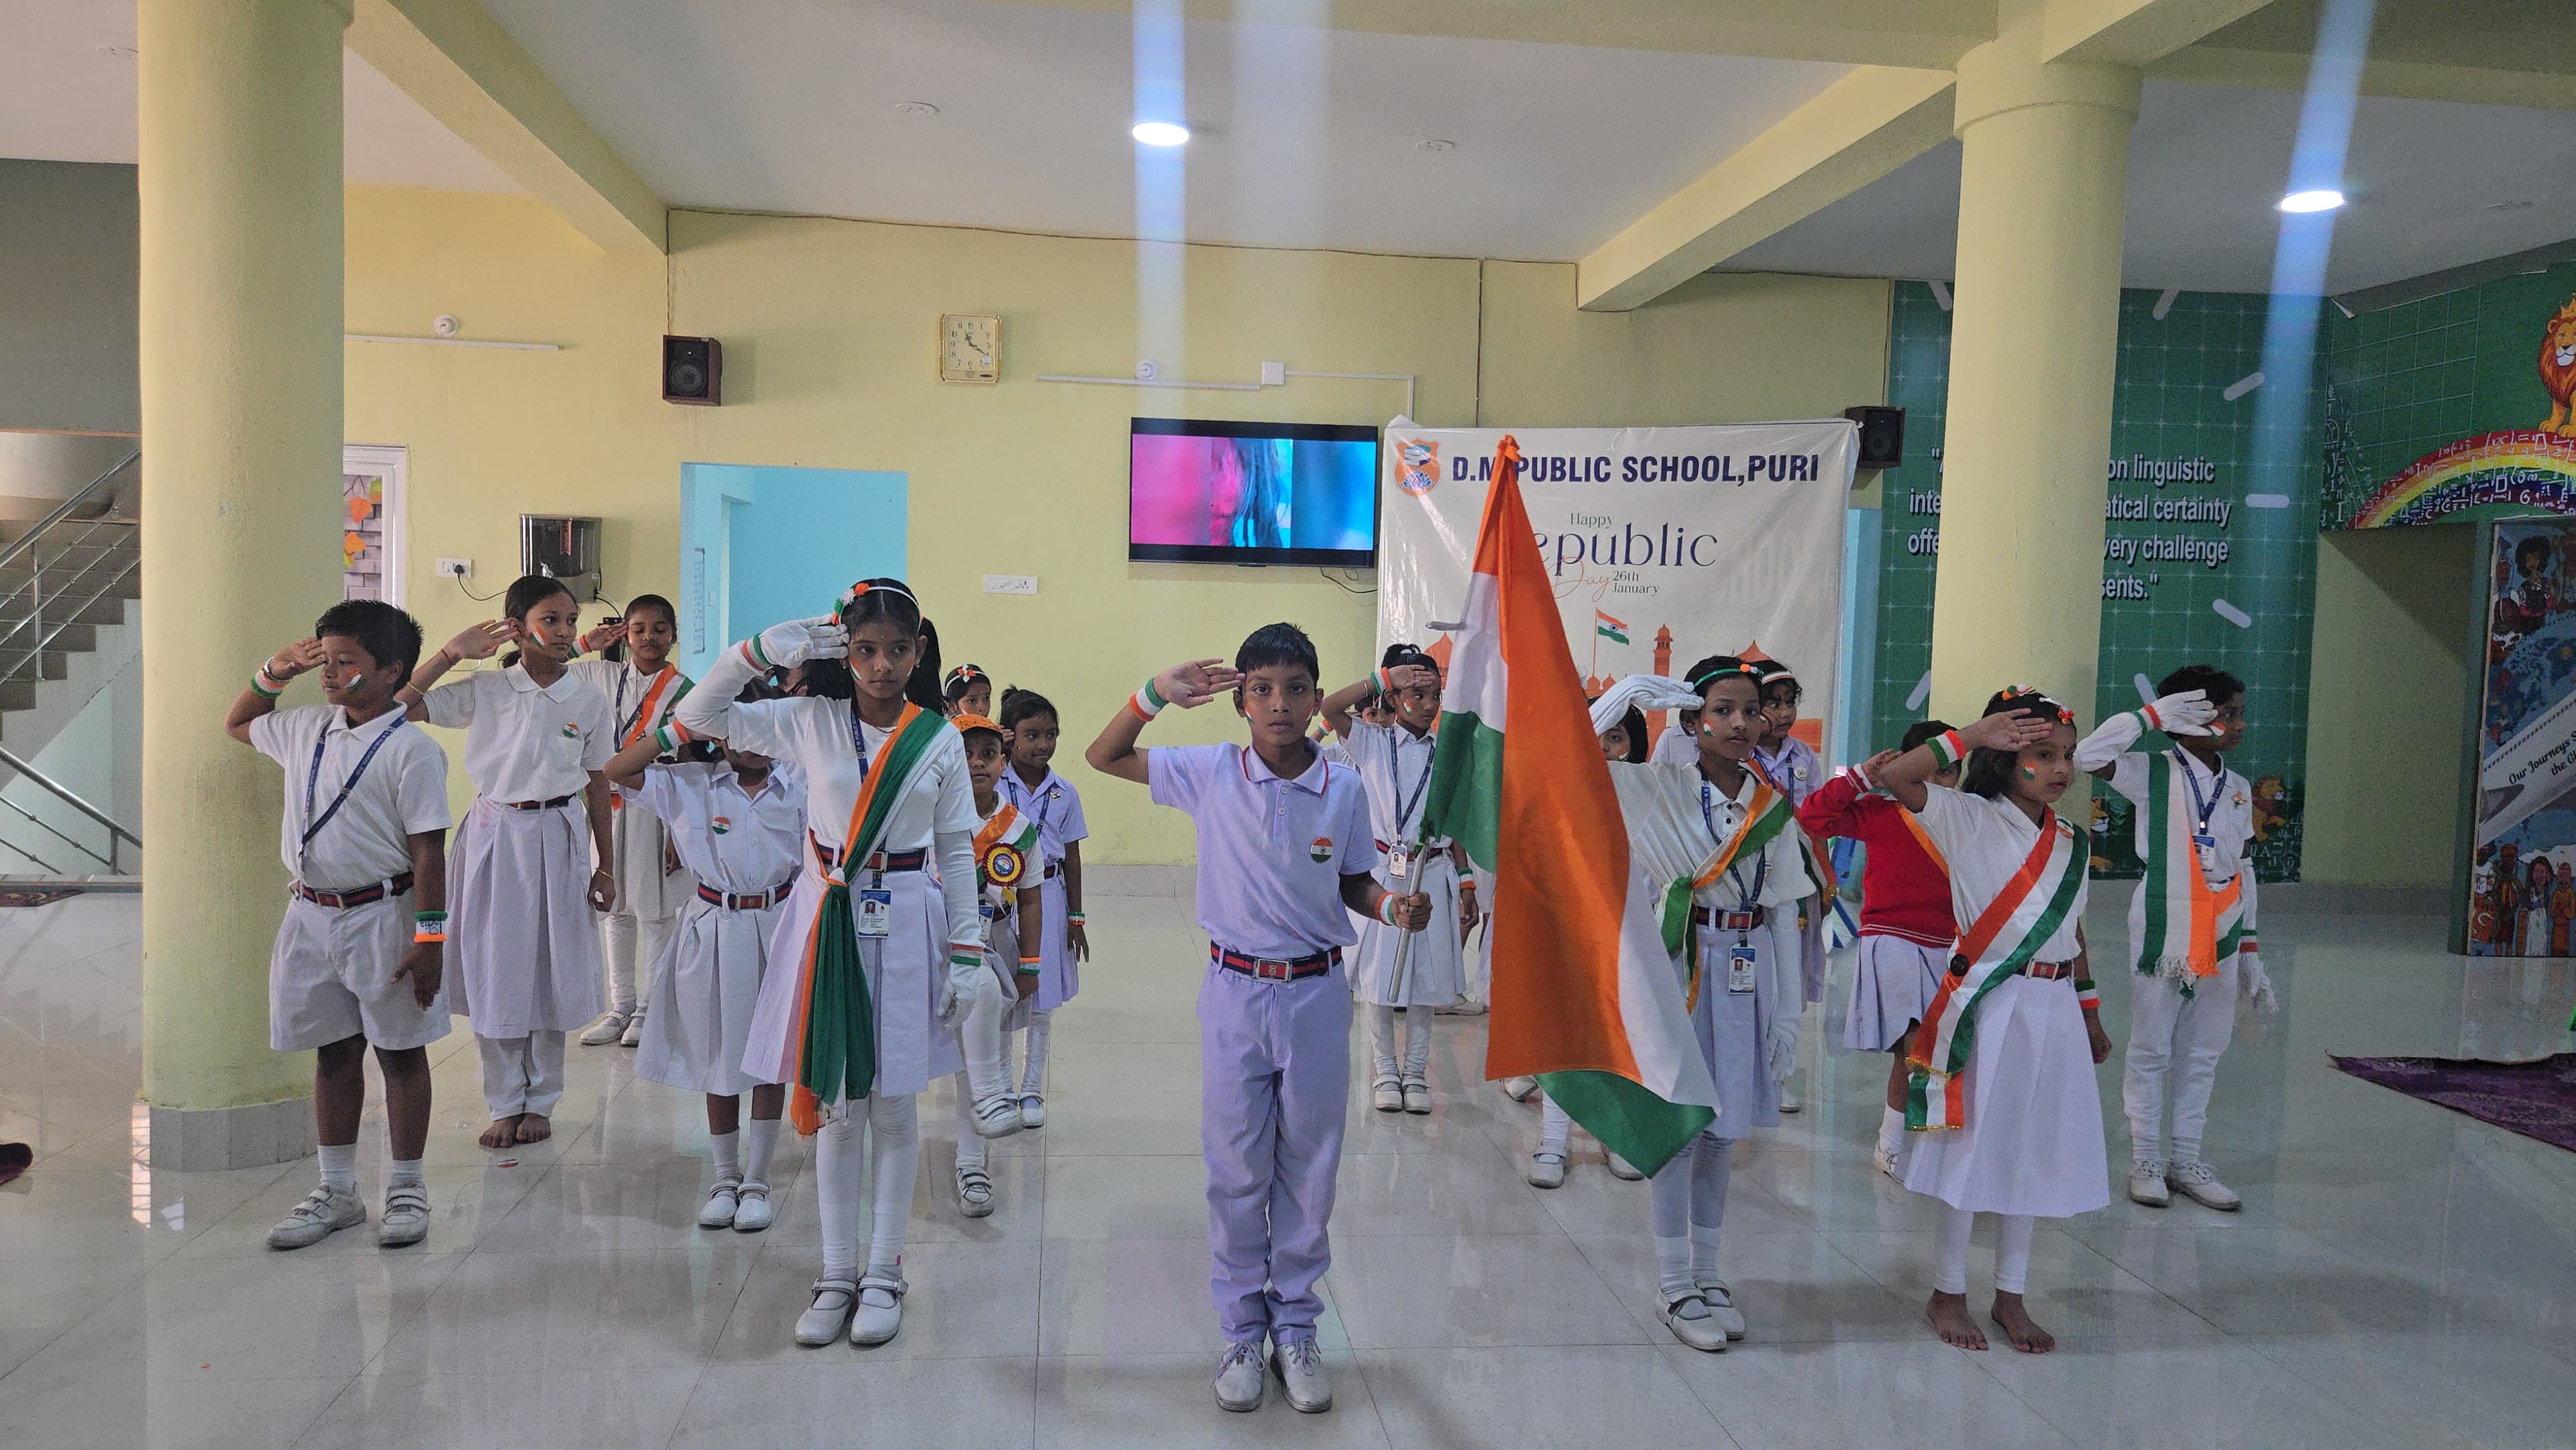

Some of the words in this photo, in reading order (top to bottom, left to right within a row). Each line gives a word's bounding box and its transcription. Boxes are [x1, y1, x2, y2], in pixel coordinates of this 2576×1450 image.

[1514, 456, 1611, 482] PUBLIC
[2134, 454, 2214, 487] linguistic
[1570, 512, 1615, 529] Happy
[1909, 488, 1941, 514] inte
[2153, 495, 2231, 528] certainty
[1907, 527, 1939, 553] offe
[2143, 535, 2228, 567] challenge
[1613, 571, 1639, 581] 26th
[1612, 582, 1659, 597] January
[2509, 767, 2527, 785] Our
[2528, 739, 2571, 774] Journeys
[2551, 762, 2567, 776] the
